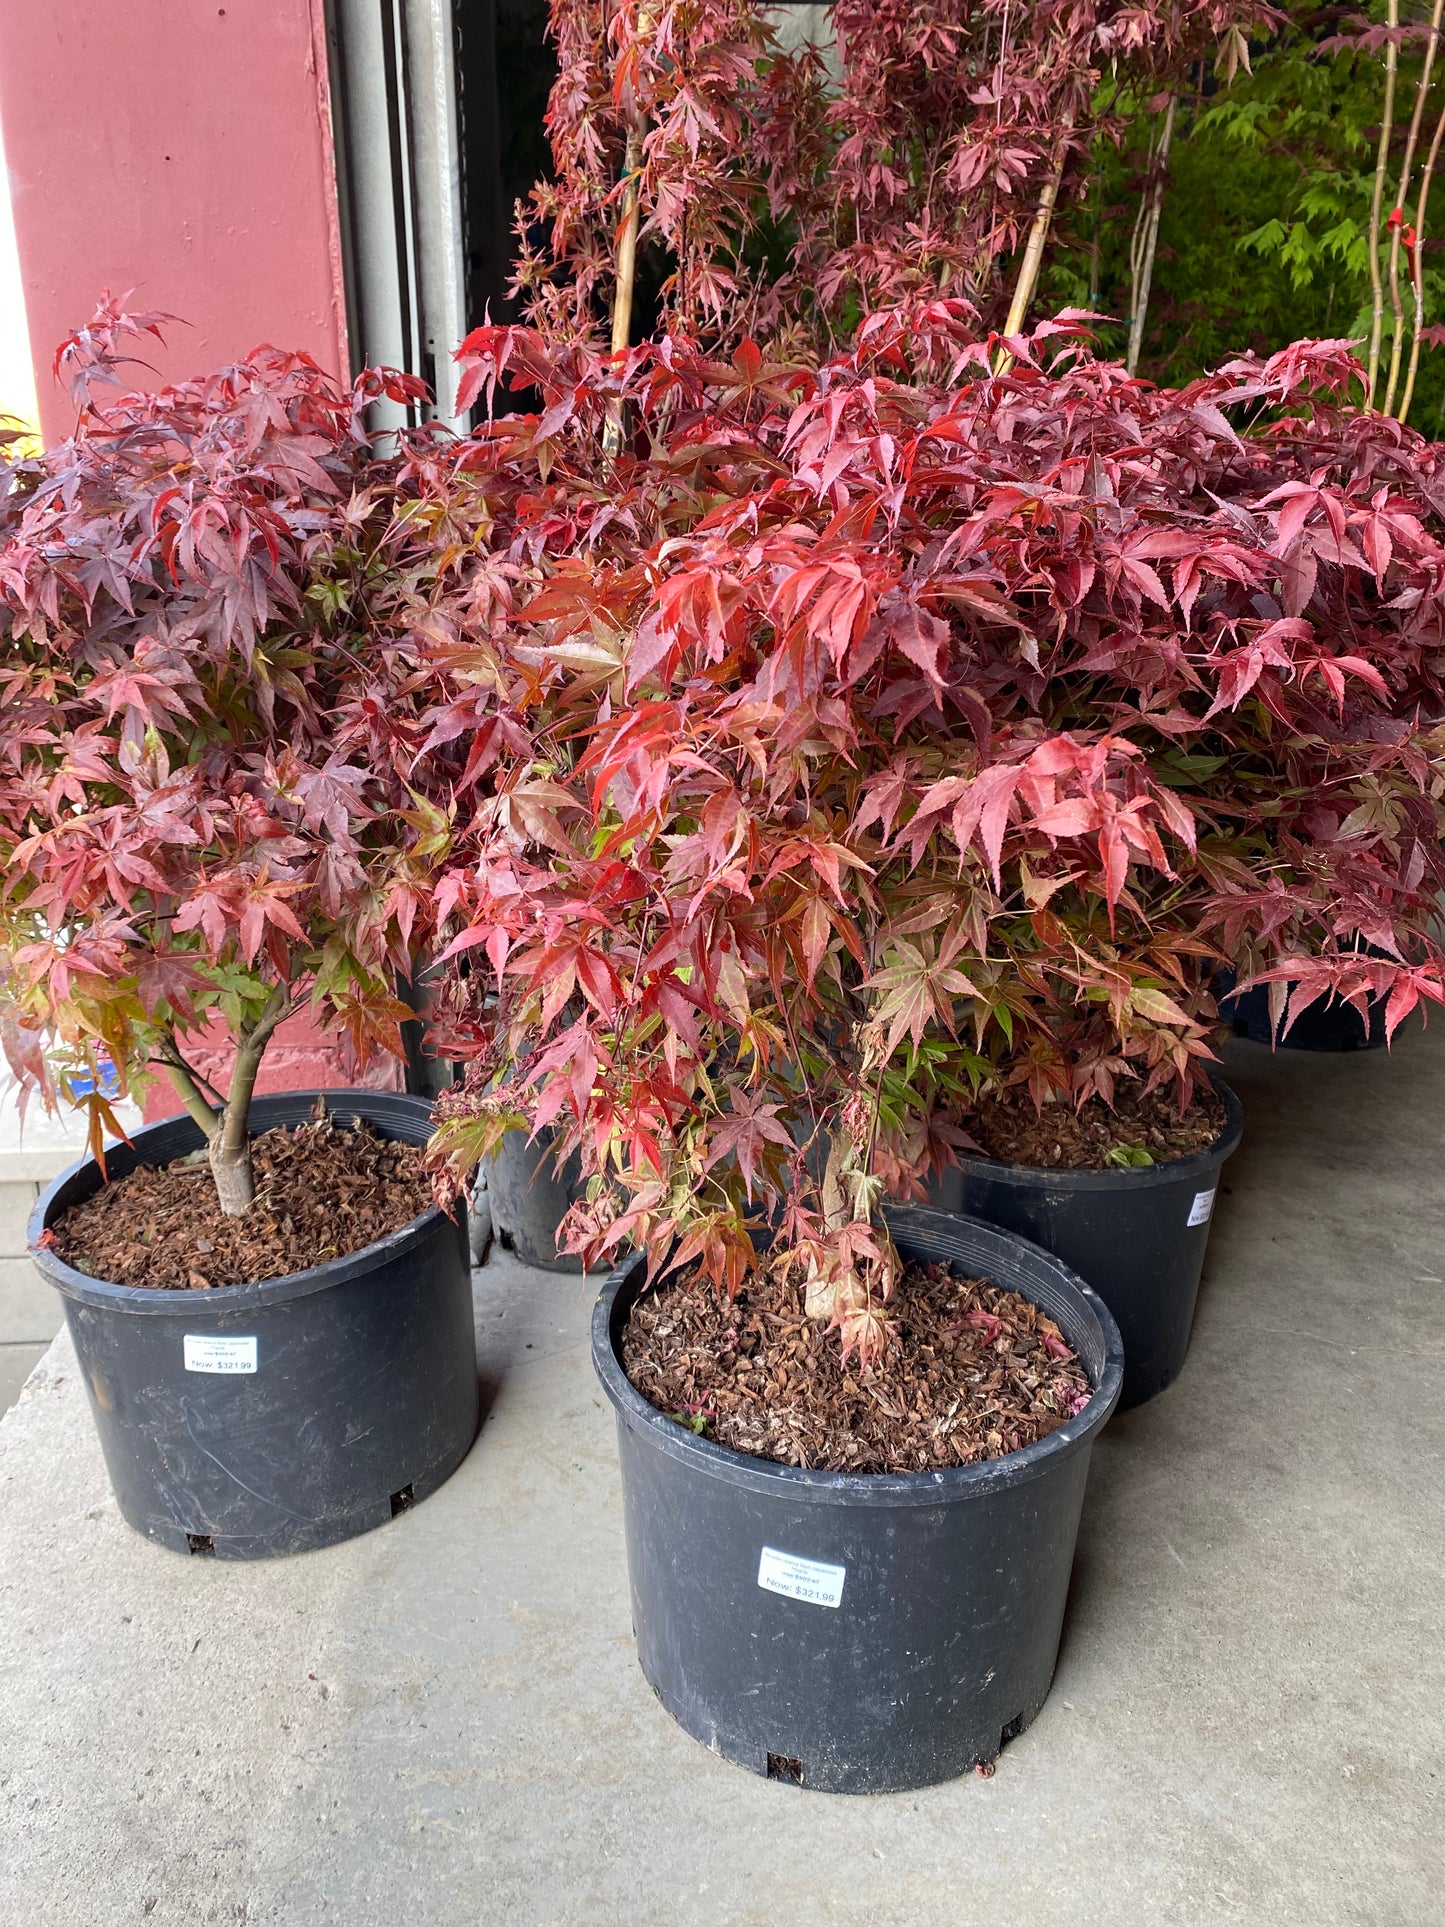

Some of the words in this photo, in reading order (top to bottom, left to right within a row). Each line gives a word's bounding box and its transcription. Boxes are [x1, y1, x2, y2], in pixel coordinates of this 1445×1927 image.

[192, 1360, 213, 1368] Now
[766, 1577, 792, 1592] Now:
[795, 1585, 835, 1602] $321.99
